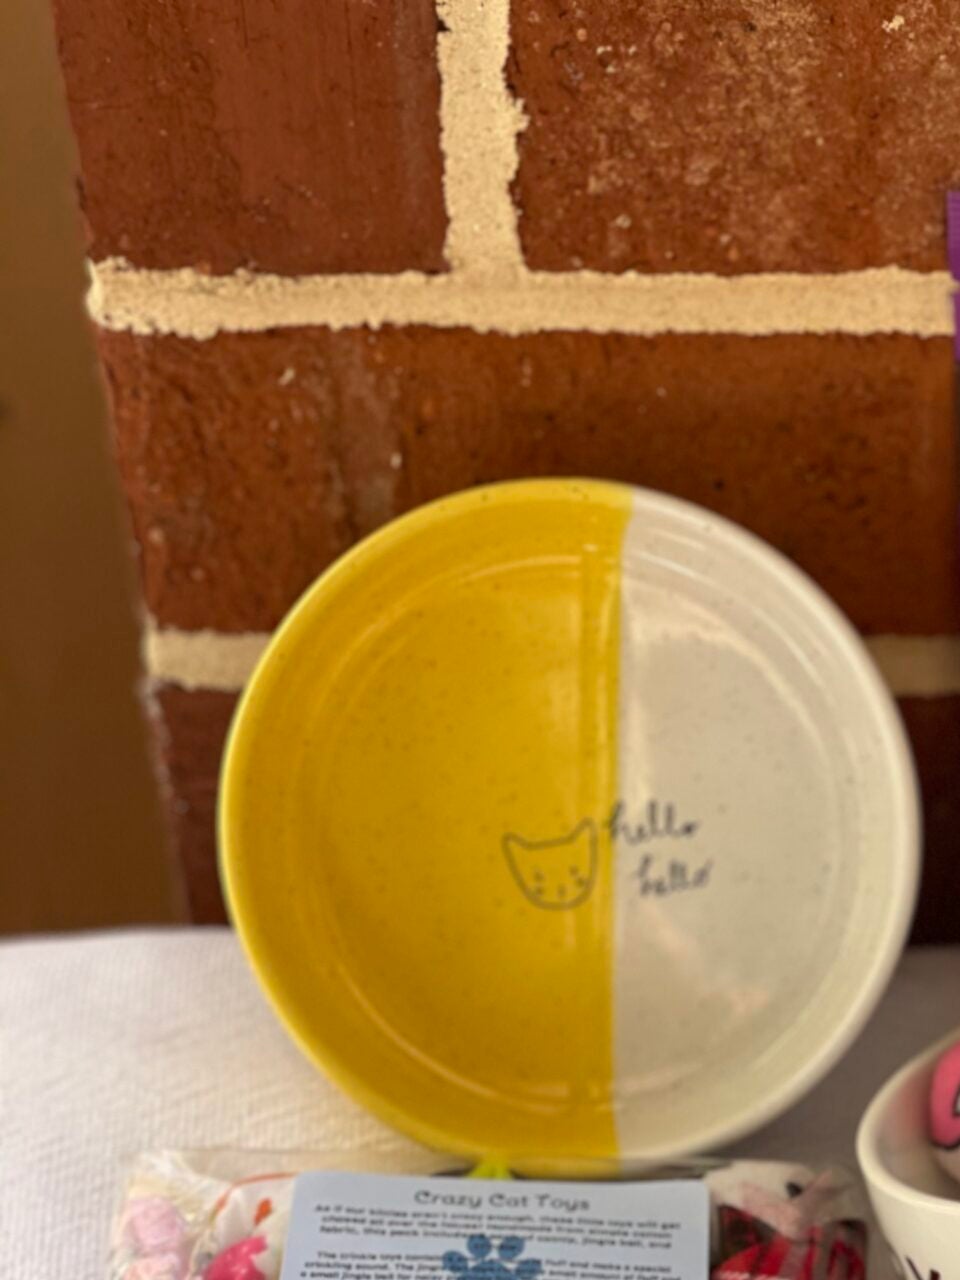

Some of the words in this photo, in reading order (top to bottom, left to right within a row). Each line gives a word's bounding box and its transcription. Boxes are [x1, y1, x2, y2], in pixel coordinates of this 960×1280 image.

[606, 798, 700, 847] hello
[637, 853, 714, 898] hello
[414, 1189, 482, 1209] Crazy
[488, 1192, 529, 1208] Cat
[536, 1194, 590, 1212] Toys
